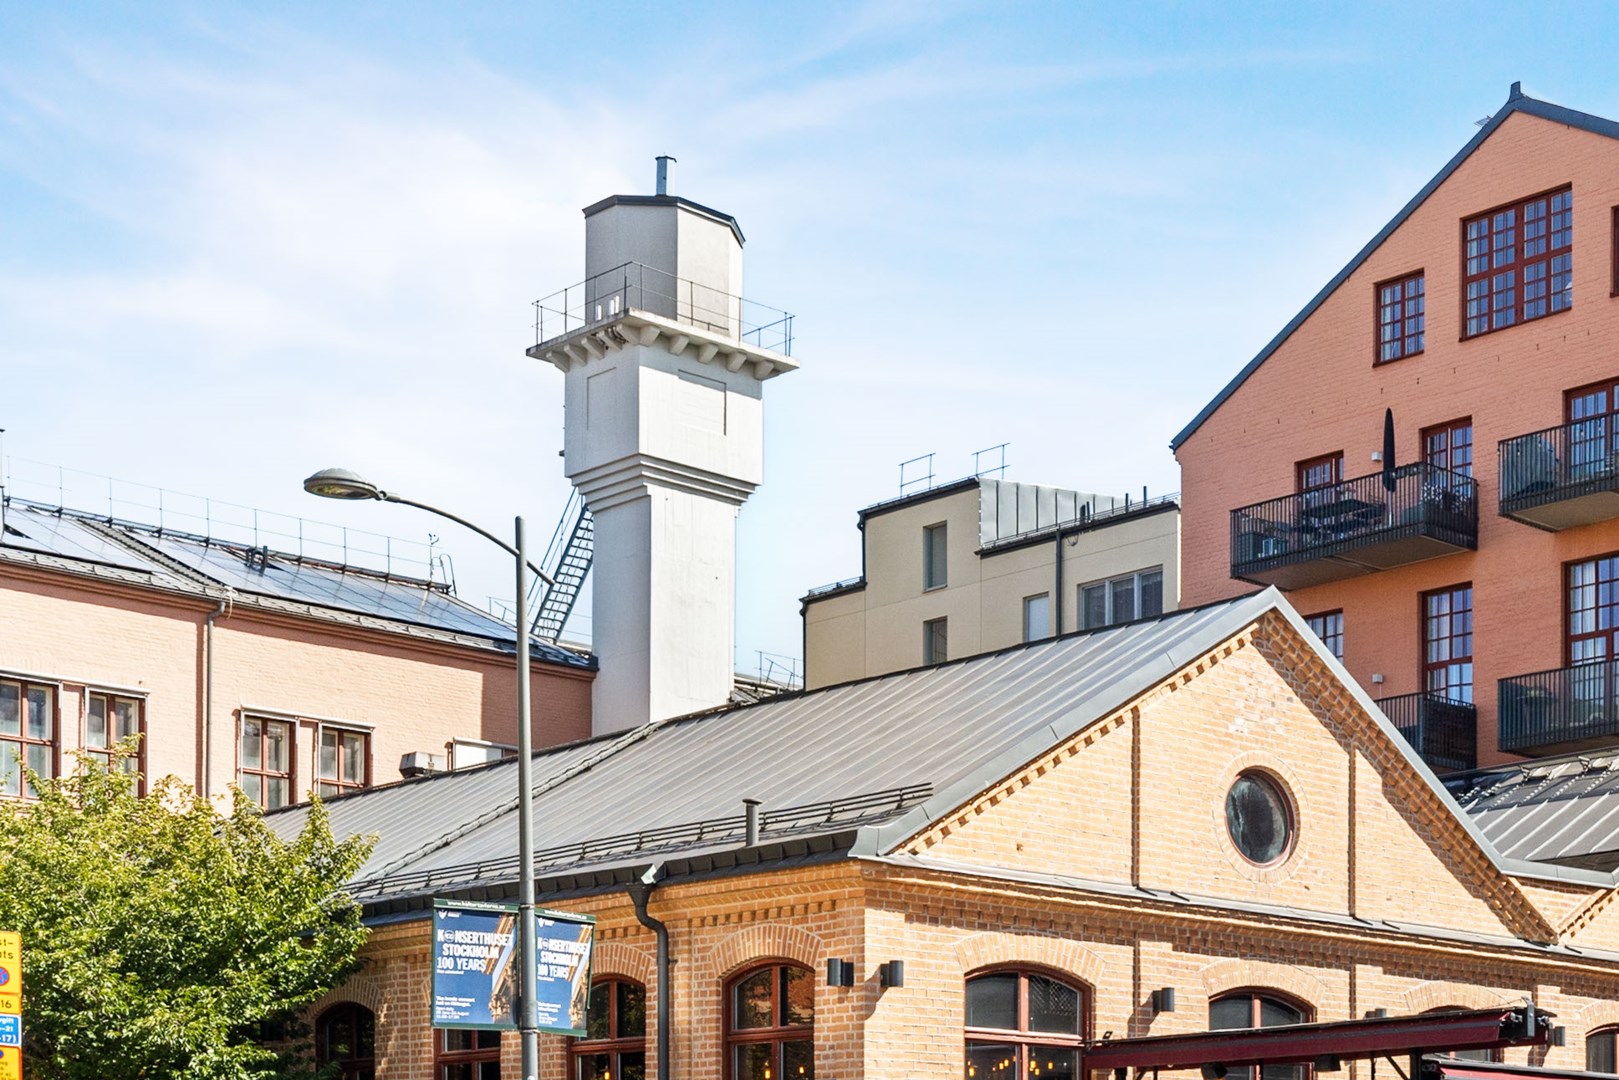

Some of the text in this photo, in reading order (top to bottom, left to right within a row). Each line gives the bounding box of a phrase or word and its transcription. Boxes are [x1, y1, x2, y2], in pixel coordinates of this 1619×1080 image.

[442, 943, 500, 959] STOCKHOLM
[540, 950, 579, 967] STOCKHOLM
[437, 956, 486, 972] 100 YEARS
[549, 965, 569, 979] YEARS
